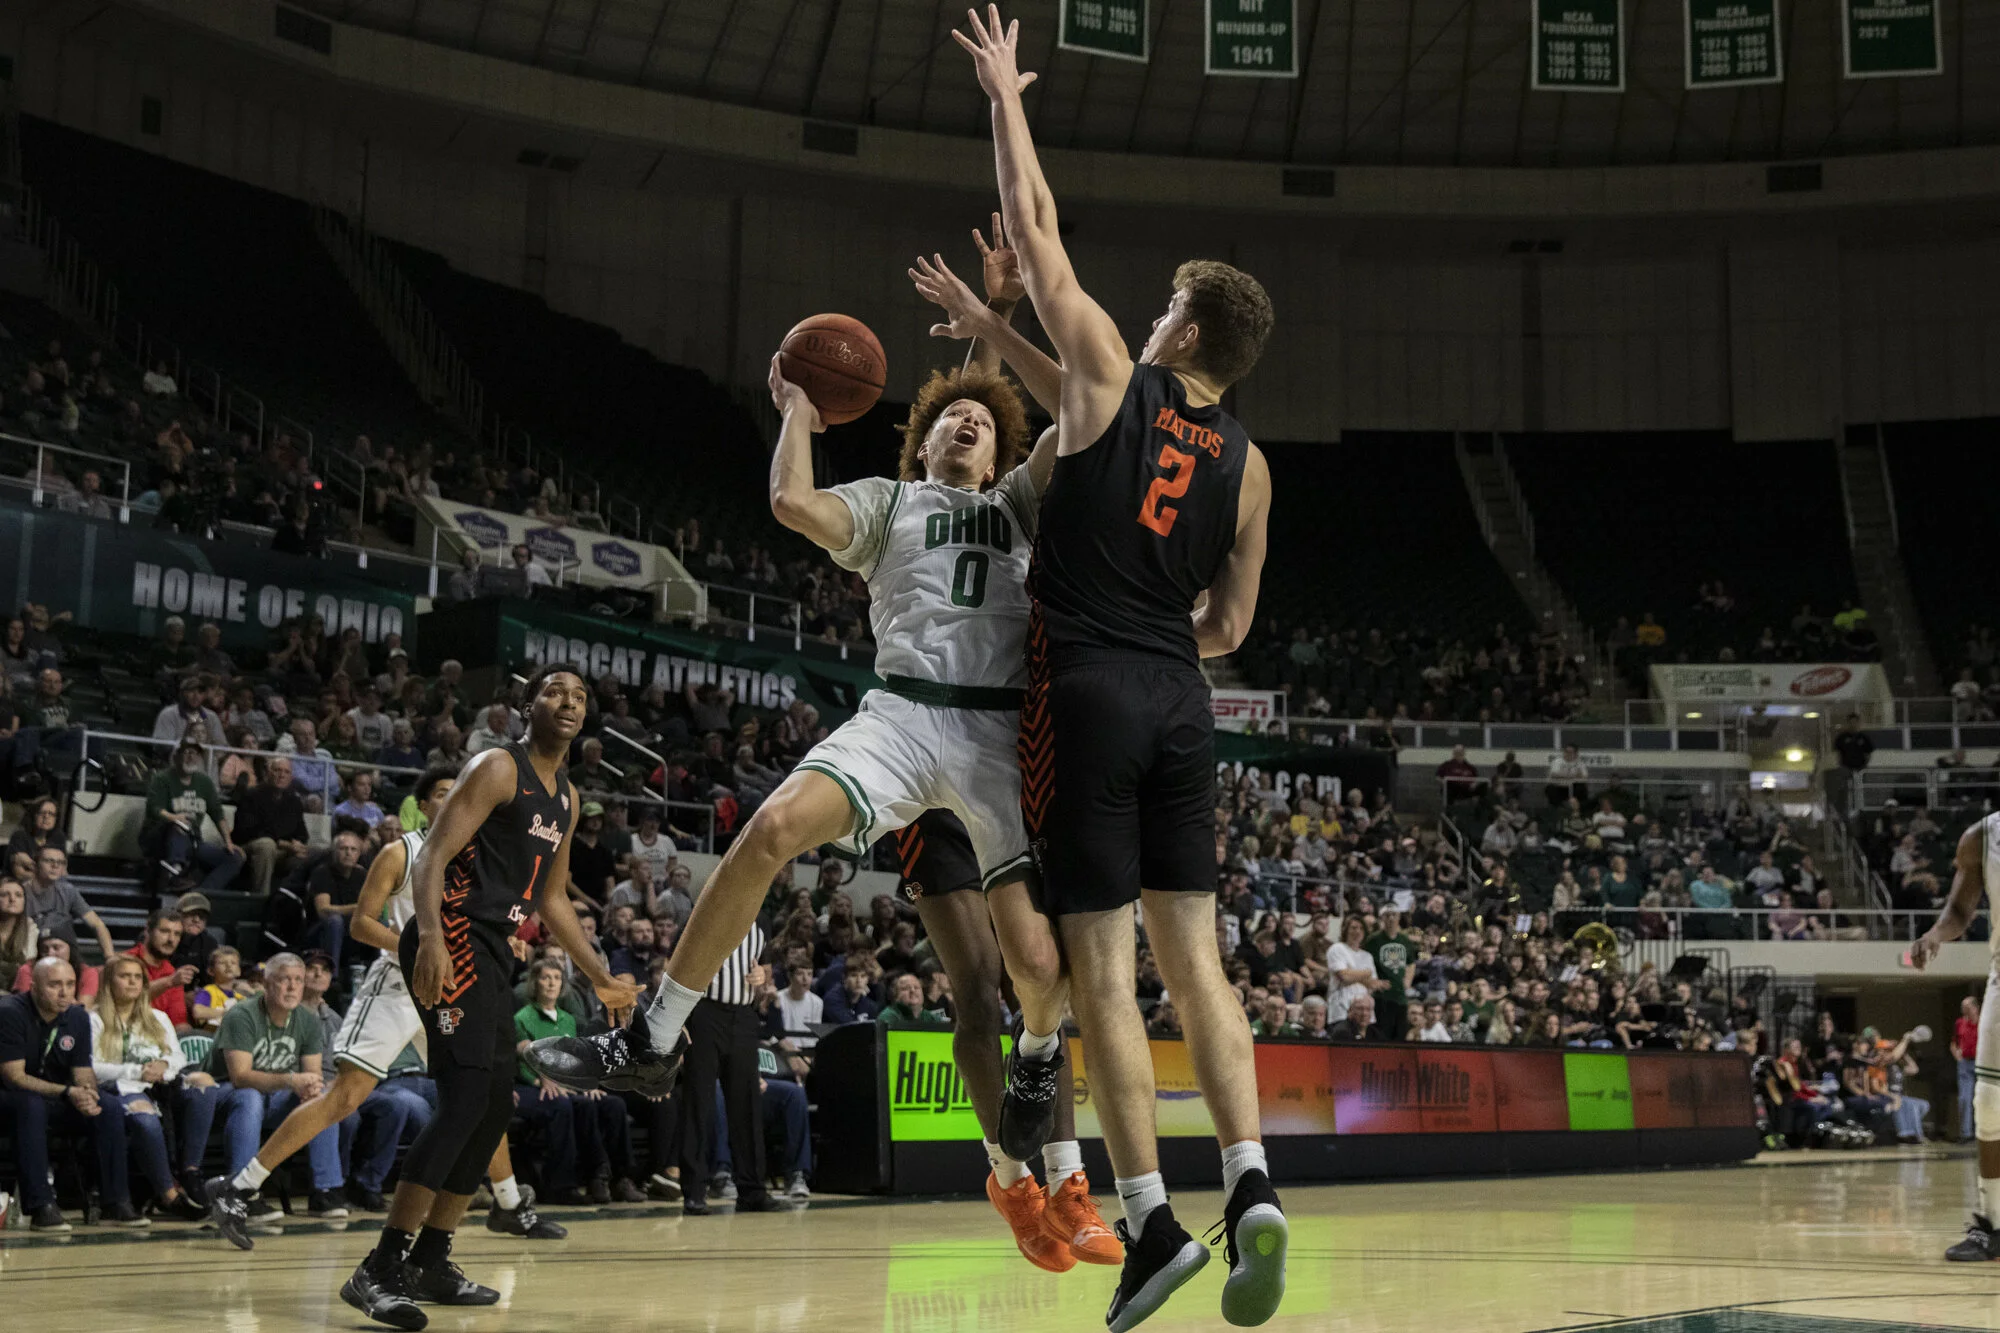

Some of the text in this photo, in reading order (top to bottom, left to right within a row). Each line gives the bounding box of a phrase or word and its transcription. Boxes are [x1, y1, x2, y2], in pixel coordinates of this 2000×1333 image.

[1216, 20, 1287, 37] RUNNER-UP
[1542, 21, 1616, 37] TOURNAMENT
[1852, 5, 1930, 20] TOURNAMENT
[1858, 25, 1889, 40] 2012
[1231, 45, 1274, 65] 1941
[1152, 407, 1224, 459] MATTOS
[1136, 444, 1197, 538] 2
[925, 503, 1012, 555] OHIO
[132, 561, 404, 644] HOME OF OHIO
[951, 550, 990, 609] 0
[524, 630, 647, 687] BOBCAT
[1210, 698, 1268, 718] SPN
[528, 813, 564, 852] Bowling
[522, 855, 543, 901] 1
[1361, 1062, 1471, 1111] Hugh White
